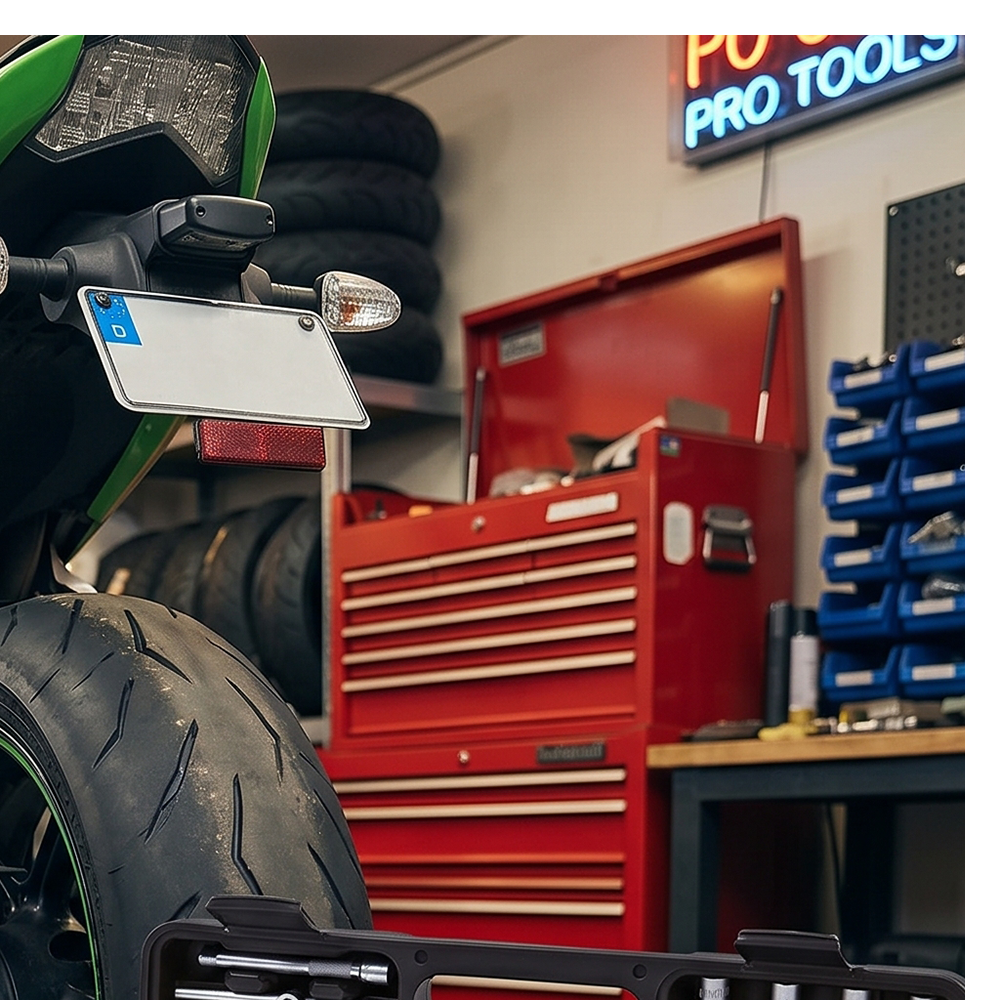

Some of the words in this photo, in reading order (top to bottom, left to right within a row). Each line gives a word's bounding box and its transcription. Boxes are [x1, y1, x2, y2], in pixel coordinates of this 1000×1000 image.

[684, 74, 781, 149] PRO
[787, 35, 959, 107] TOOLS
[111, 324, 127, 338] D
